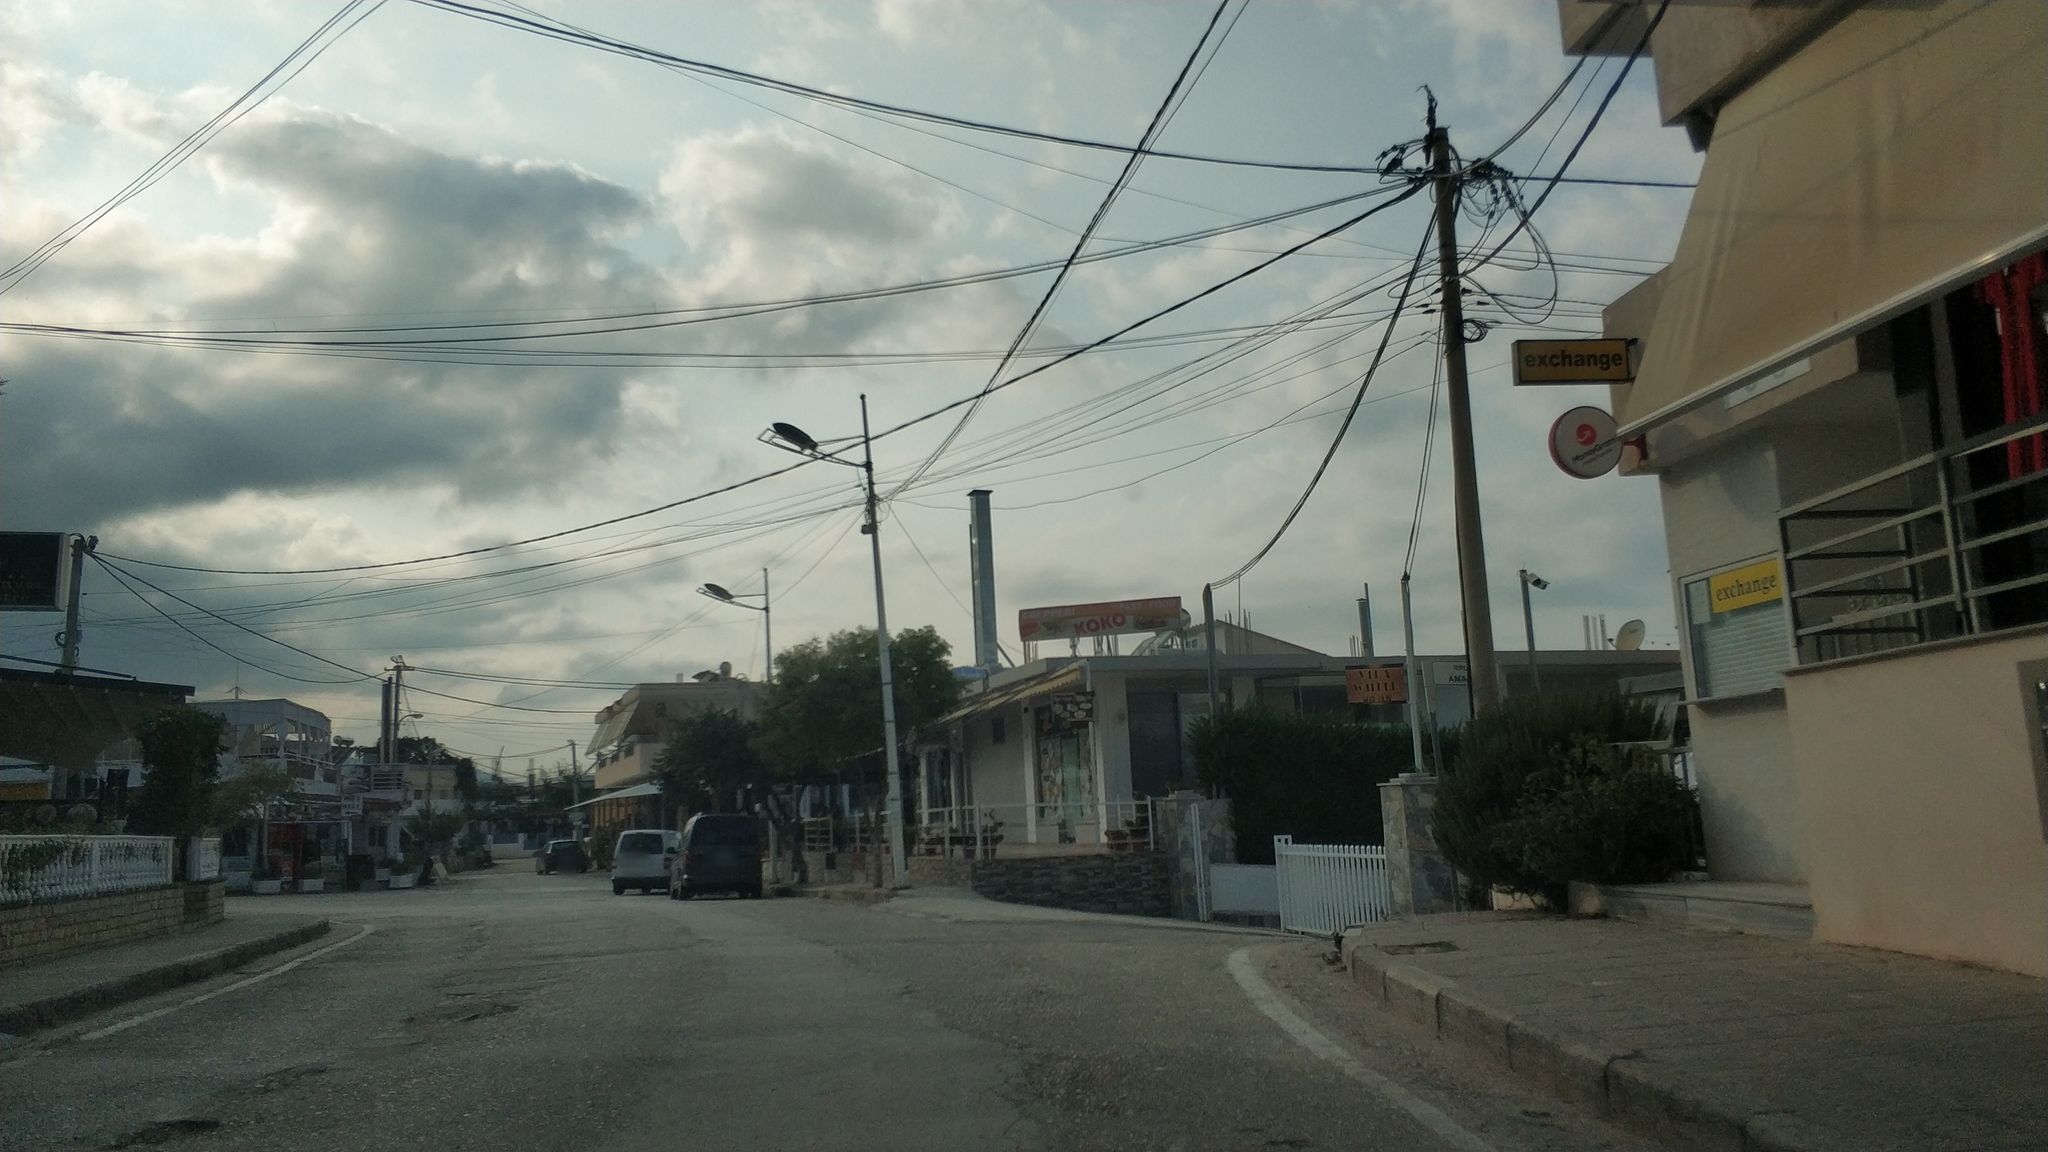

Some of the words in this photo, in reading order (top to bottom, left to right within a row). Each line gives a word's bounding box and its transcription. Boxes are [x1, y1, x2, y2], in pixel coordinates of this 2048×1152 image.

[1525, 350, 1622, 371] exchange
[1715, 574, 1777, 602] exchange
[1074, 612, 1126, 636] KOKO
